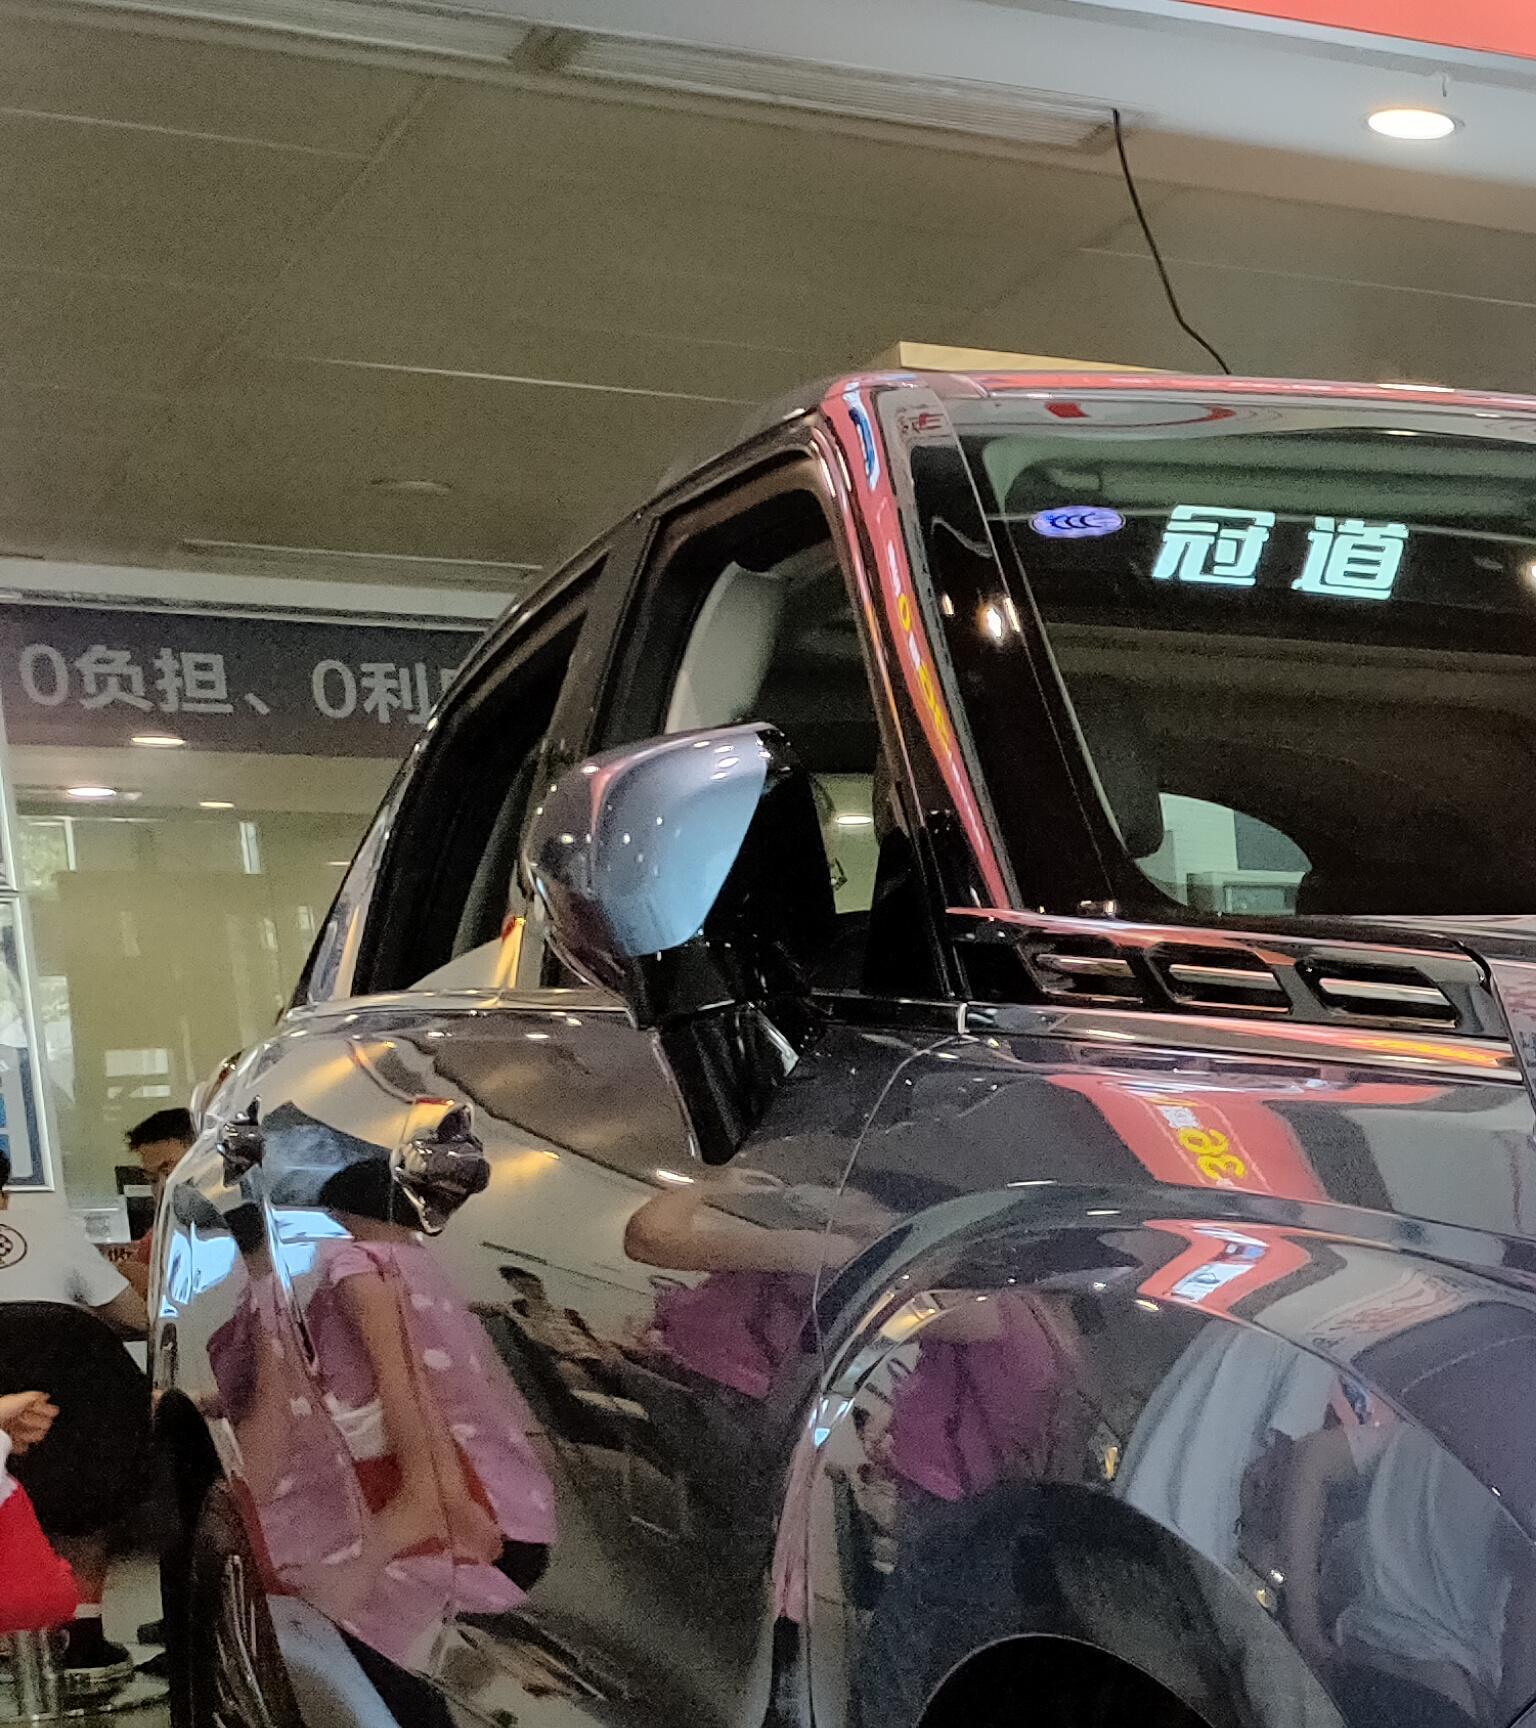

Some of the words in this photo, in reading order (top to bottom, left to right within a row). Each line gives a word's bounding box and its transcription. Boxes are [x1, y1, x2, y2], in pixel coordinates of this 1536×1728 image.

[1152, 504, 1410, 600] 冠道
[18, 643, 458, 725] 0负担、0利
